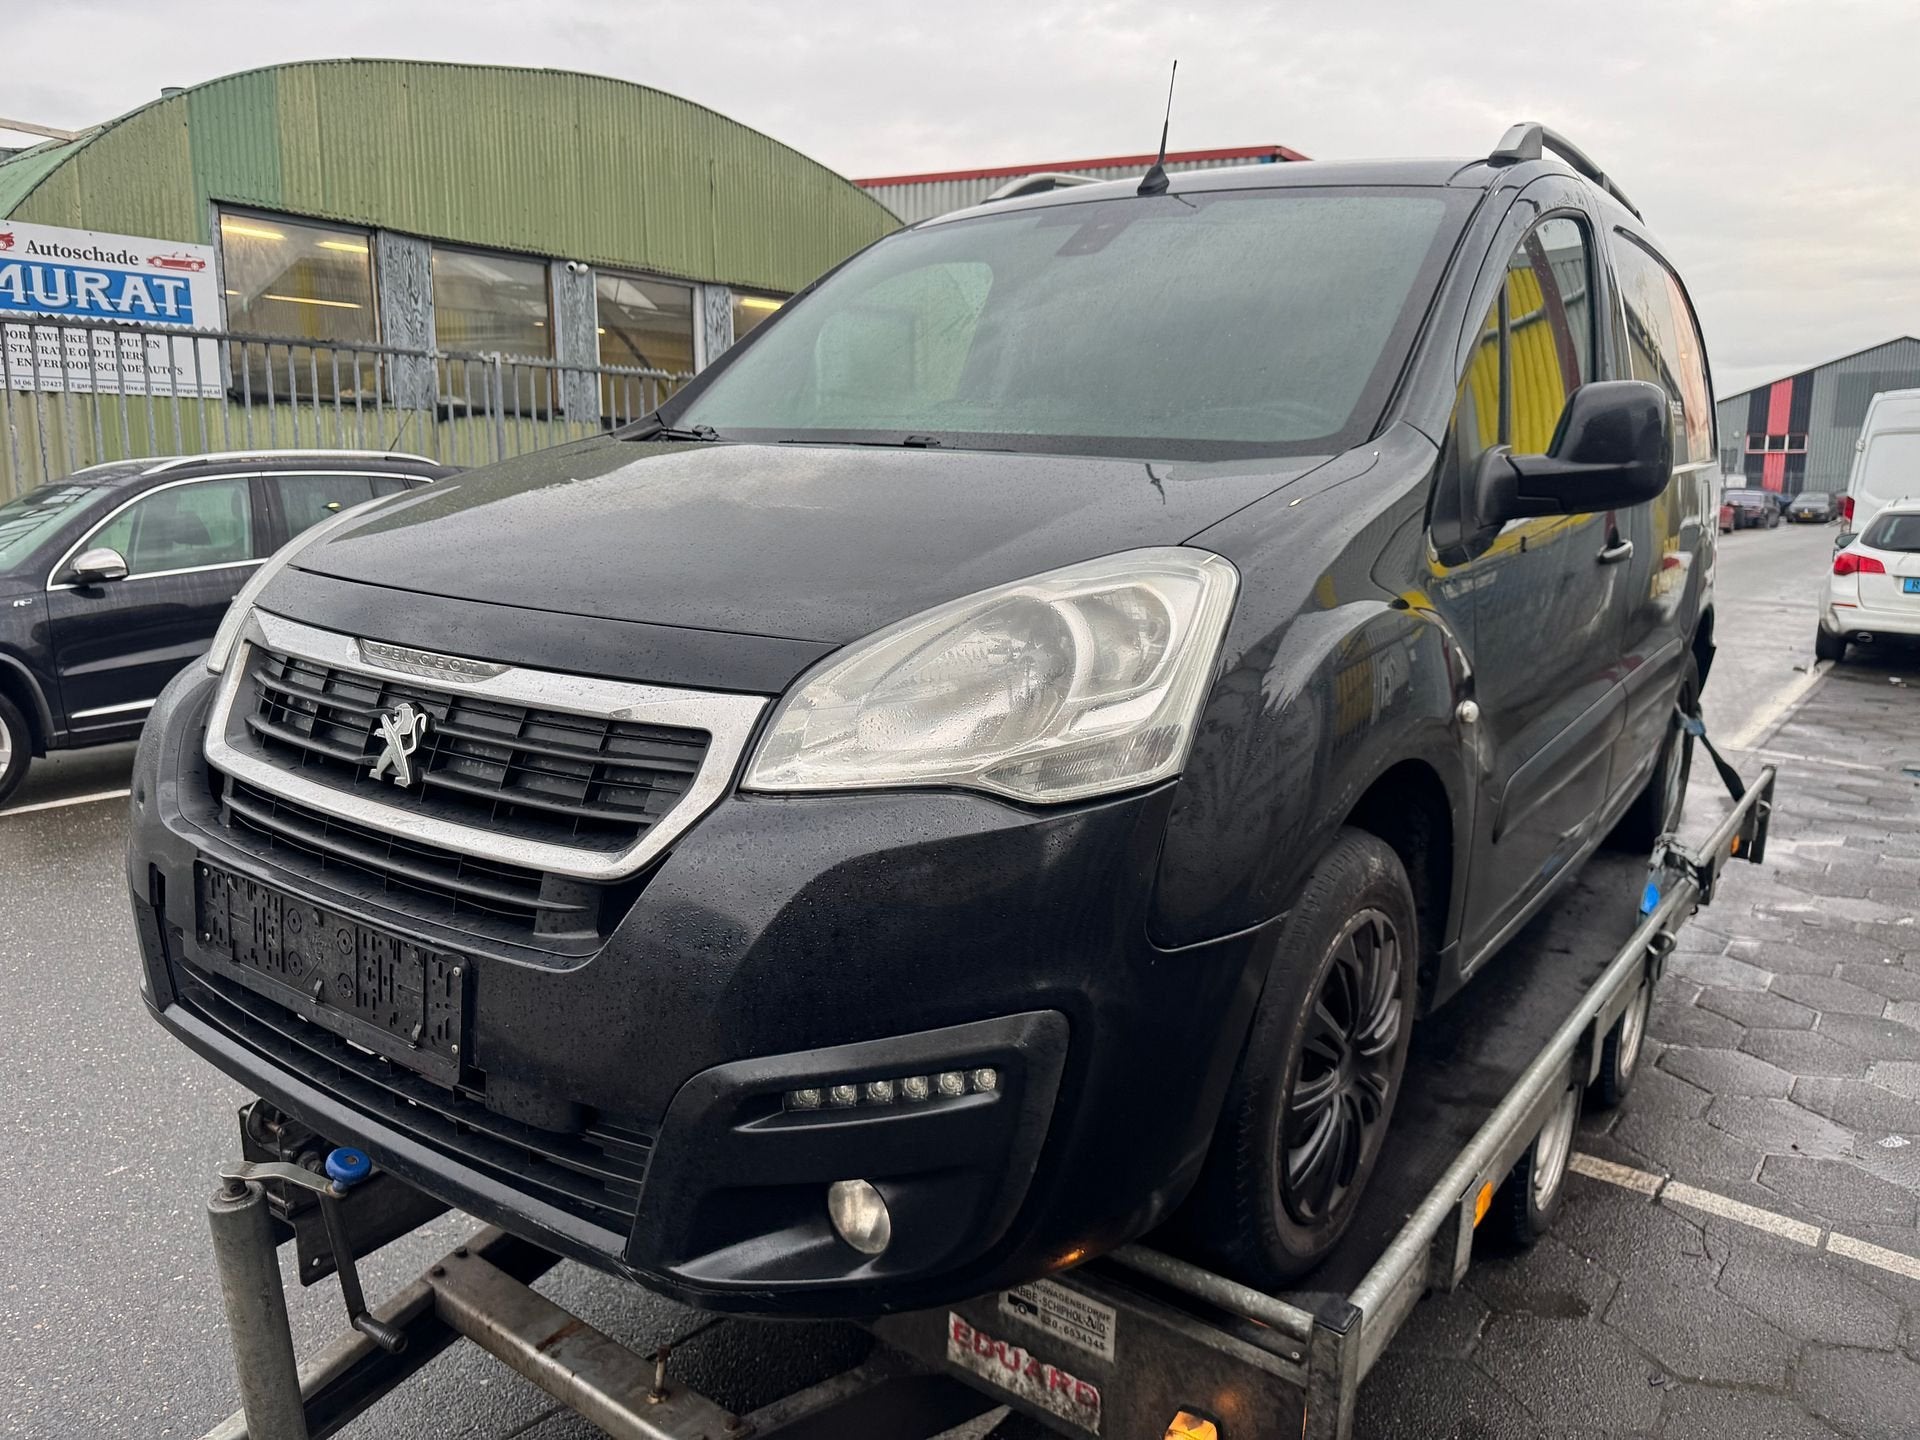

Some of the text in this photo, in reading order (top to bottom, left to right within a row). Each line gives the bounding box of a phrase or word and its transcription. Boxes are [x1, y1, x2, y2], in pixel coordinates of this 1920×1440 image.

[25, 239, 139, 266] Autoschade
[96, 336, 110, 345] EN
[953, 1320, 1099, 1408] EDUARD
